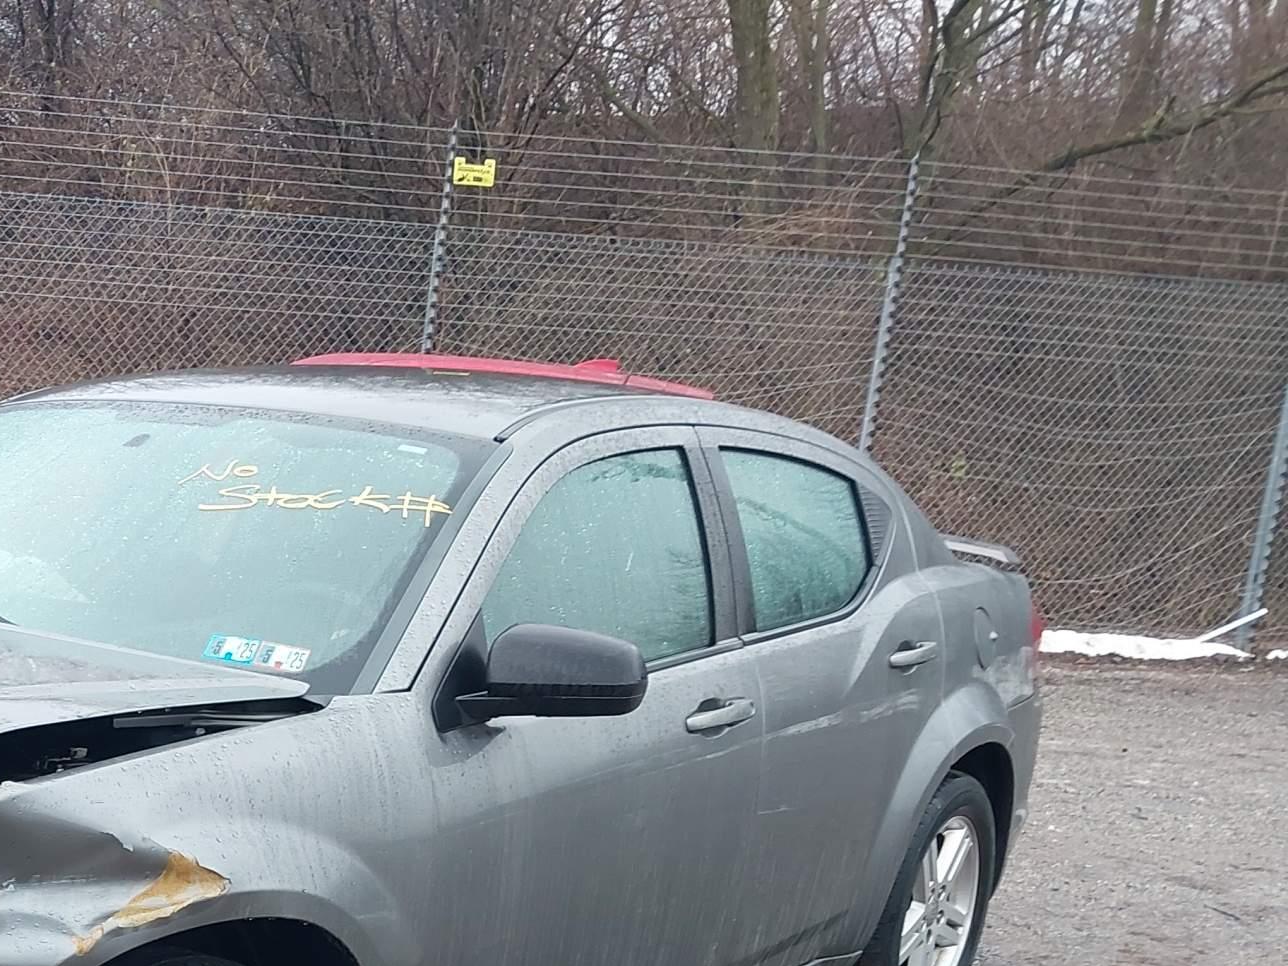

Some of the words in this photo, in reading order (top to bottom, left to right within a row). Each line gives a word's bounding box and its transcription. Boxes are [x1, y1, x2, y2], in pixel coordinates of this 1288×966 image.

[240, 642, 256, 659] 25
[262, 648, 274, 664] 5
[290, 651, 306, 669] 25
